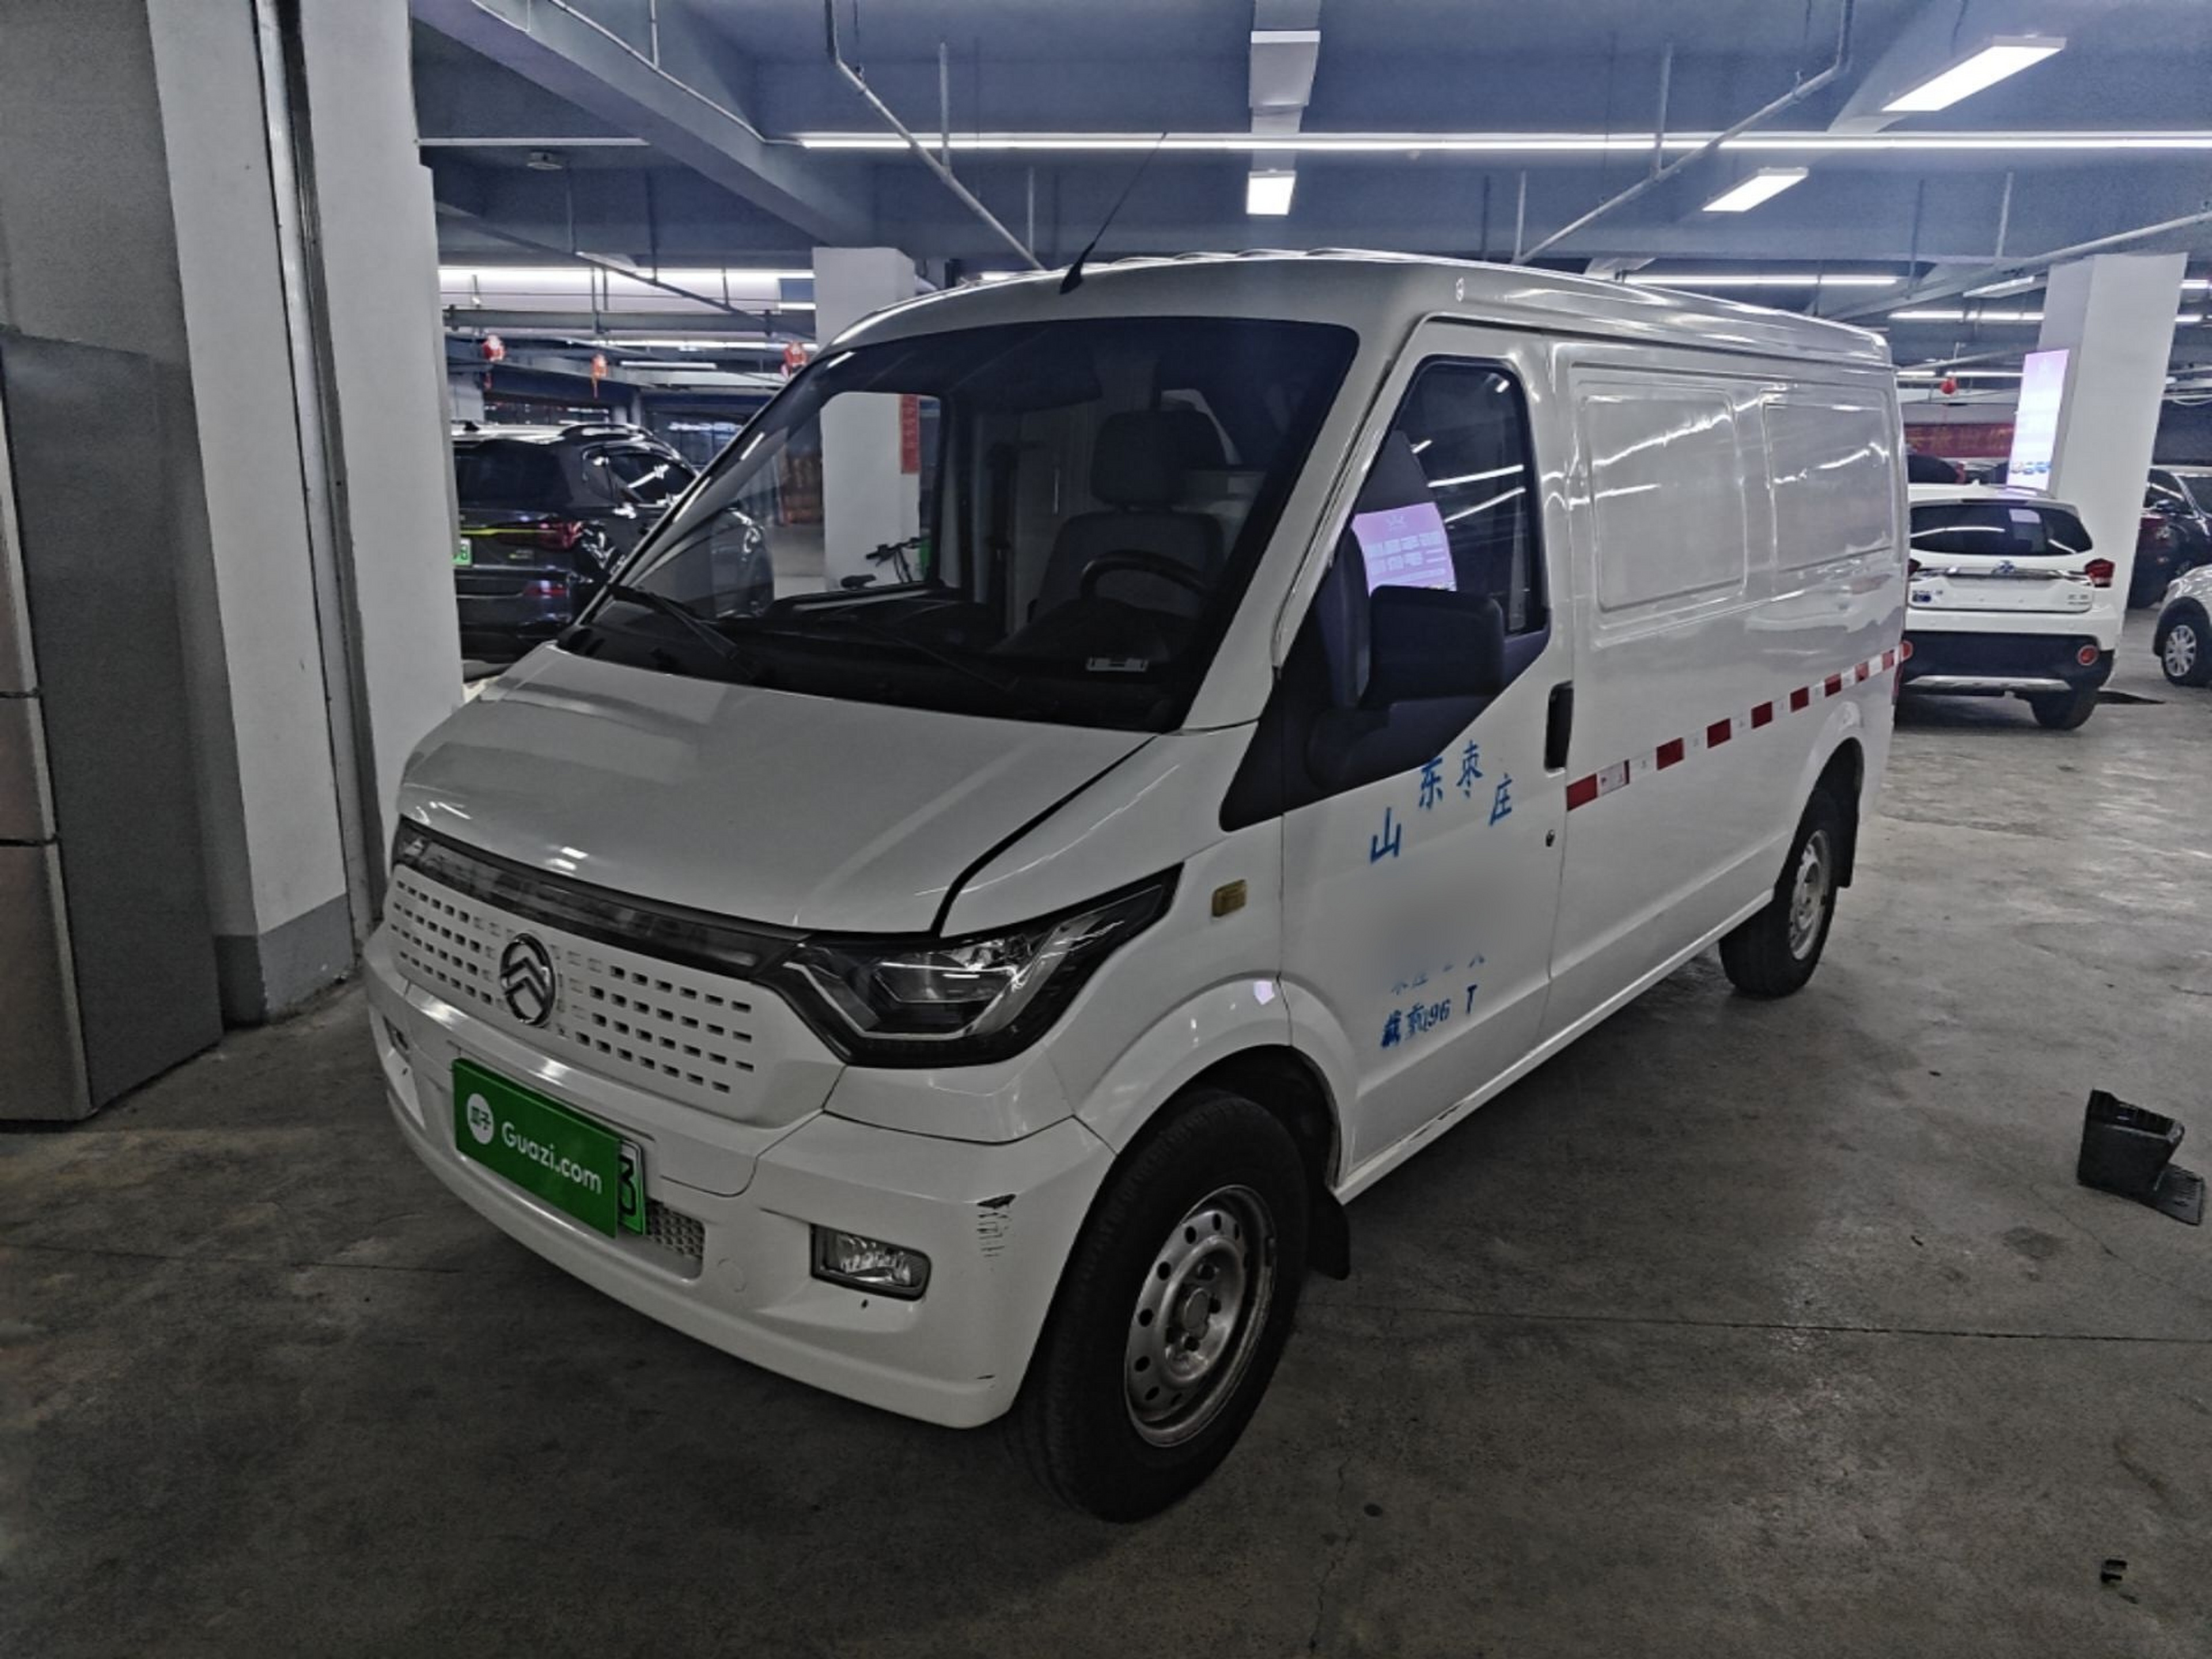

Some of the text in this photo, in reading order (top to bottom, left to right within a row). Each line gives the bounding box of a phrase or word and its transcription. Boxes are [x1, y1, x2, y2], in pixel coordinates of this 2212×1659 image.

[1370, 740, 1514, 863] 山东枣庄
[501, 1121, 603, 1195] Guazi.com
